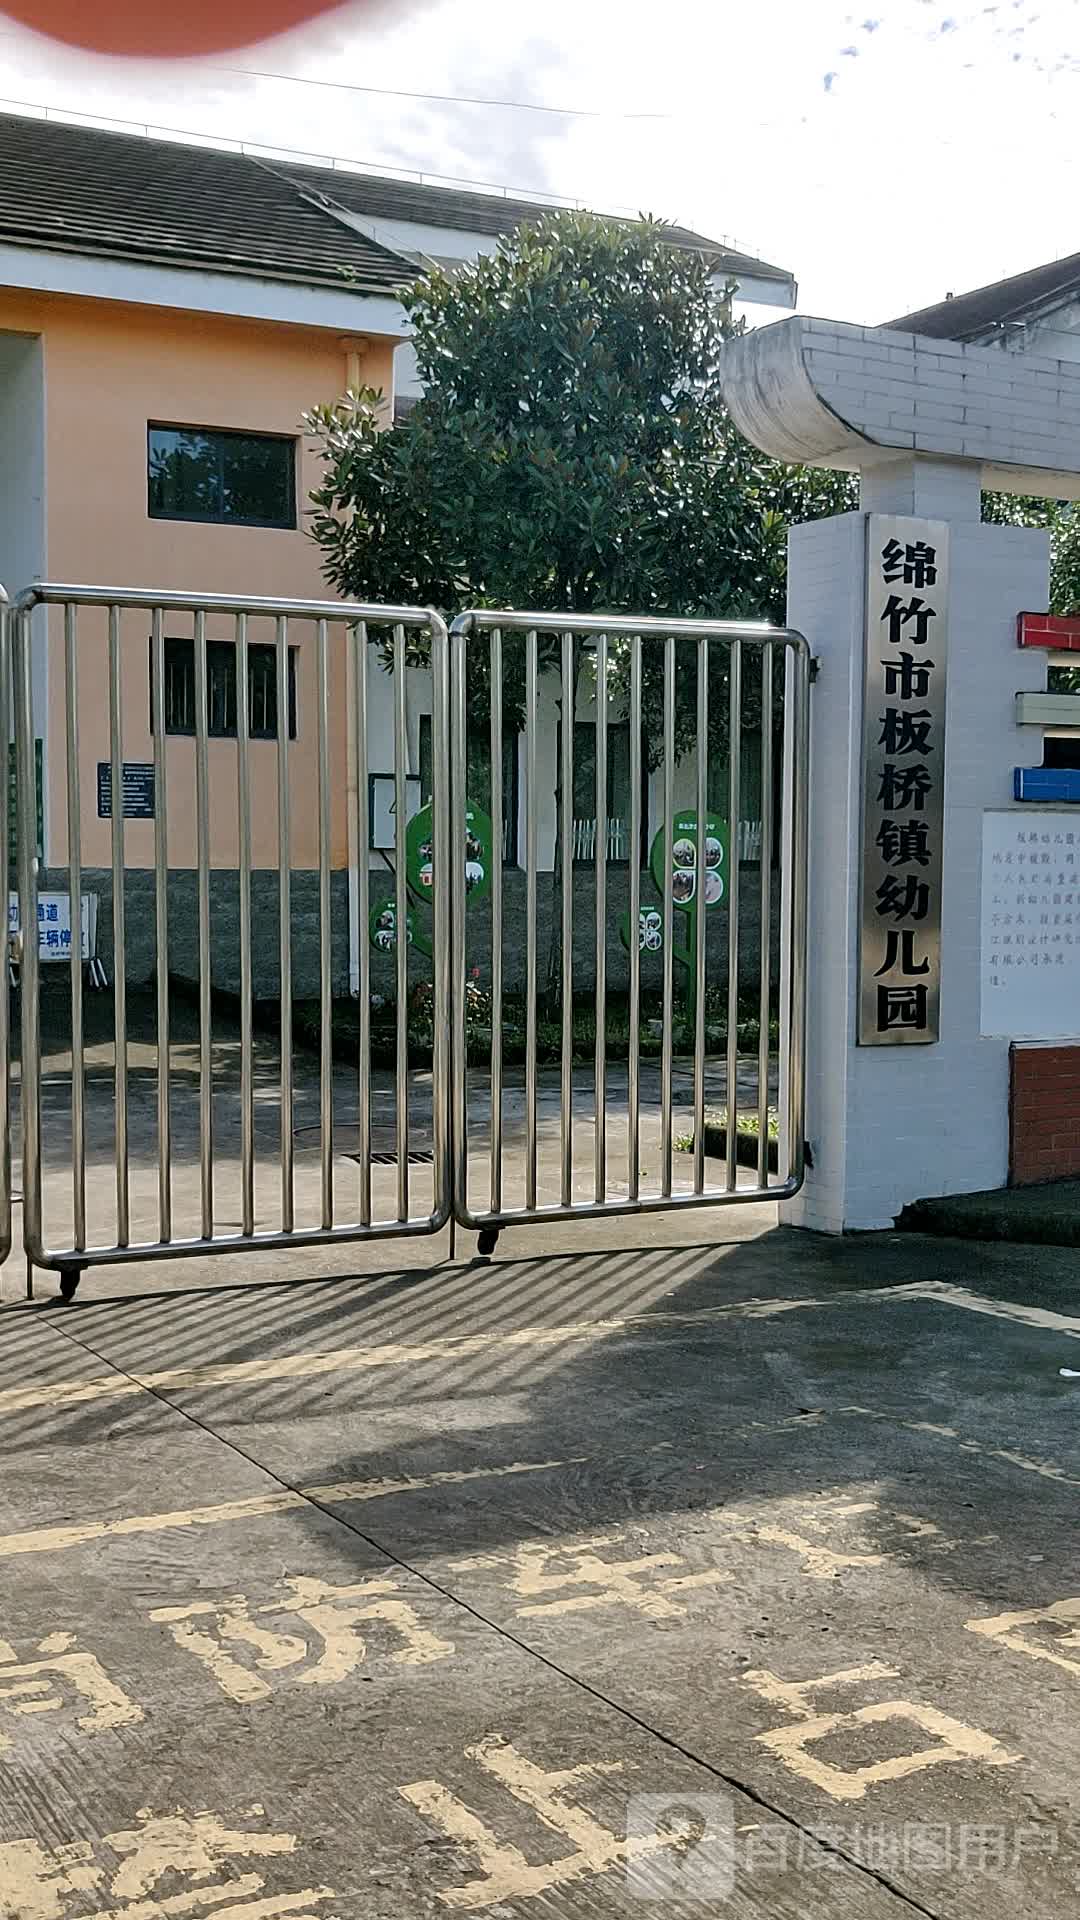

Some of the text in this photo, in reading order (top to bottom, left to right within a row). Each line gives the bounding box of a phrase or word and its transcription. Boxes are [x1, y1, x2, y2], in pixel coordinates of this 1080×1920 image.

[873, 538, 938, 1032] 绵竹市板桥镇幼儿园
